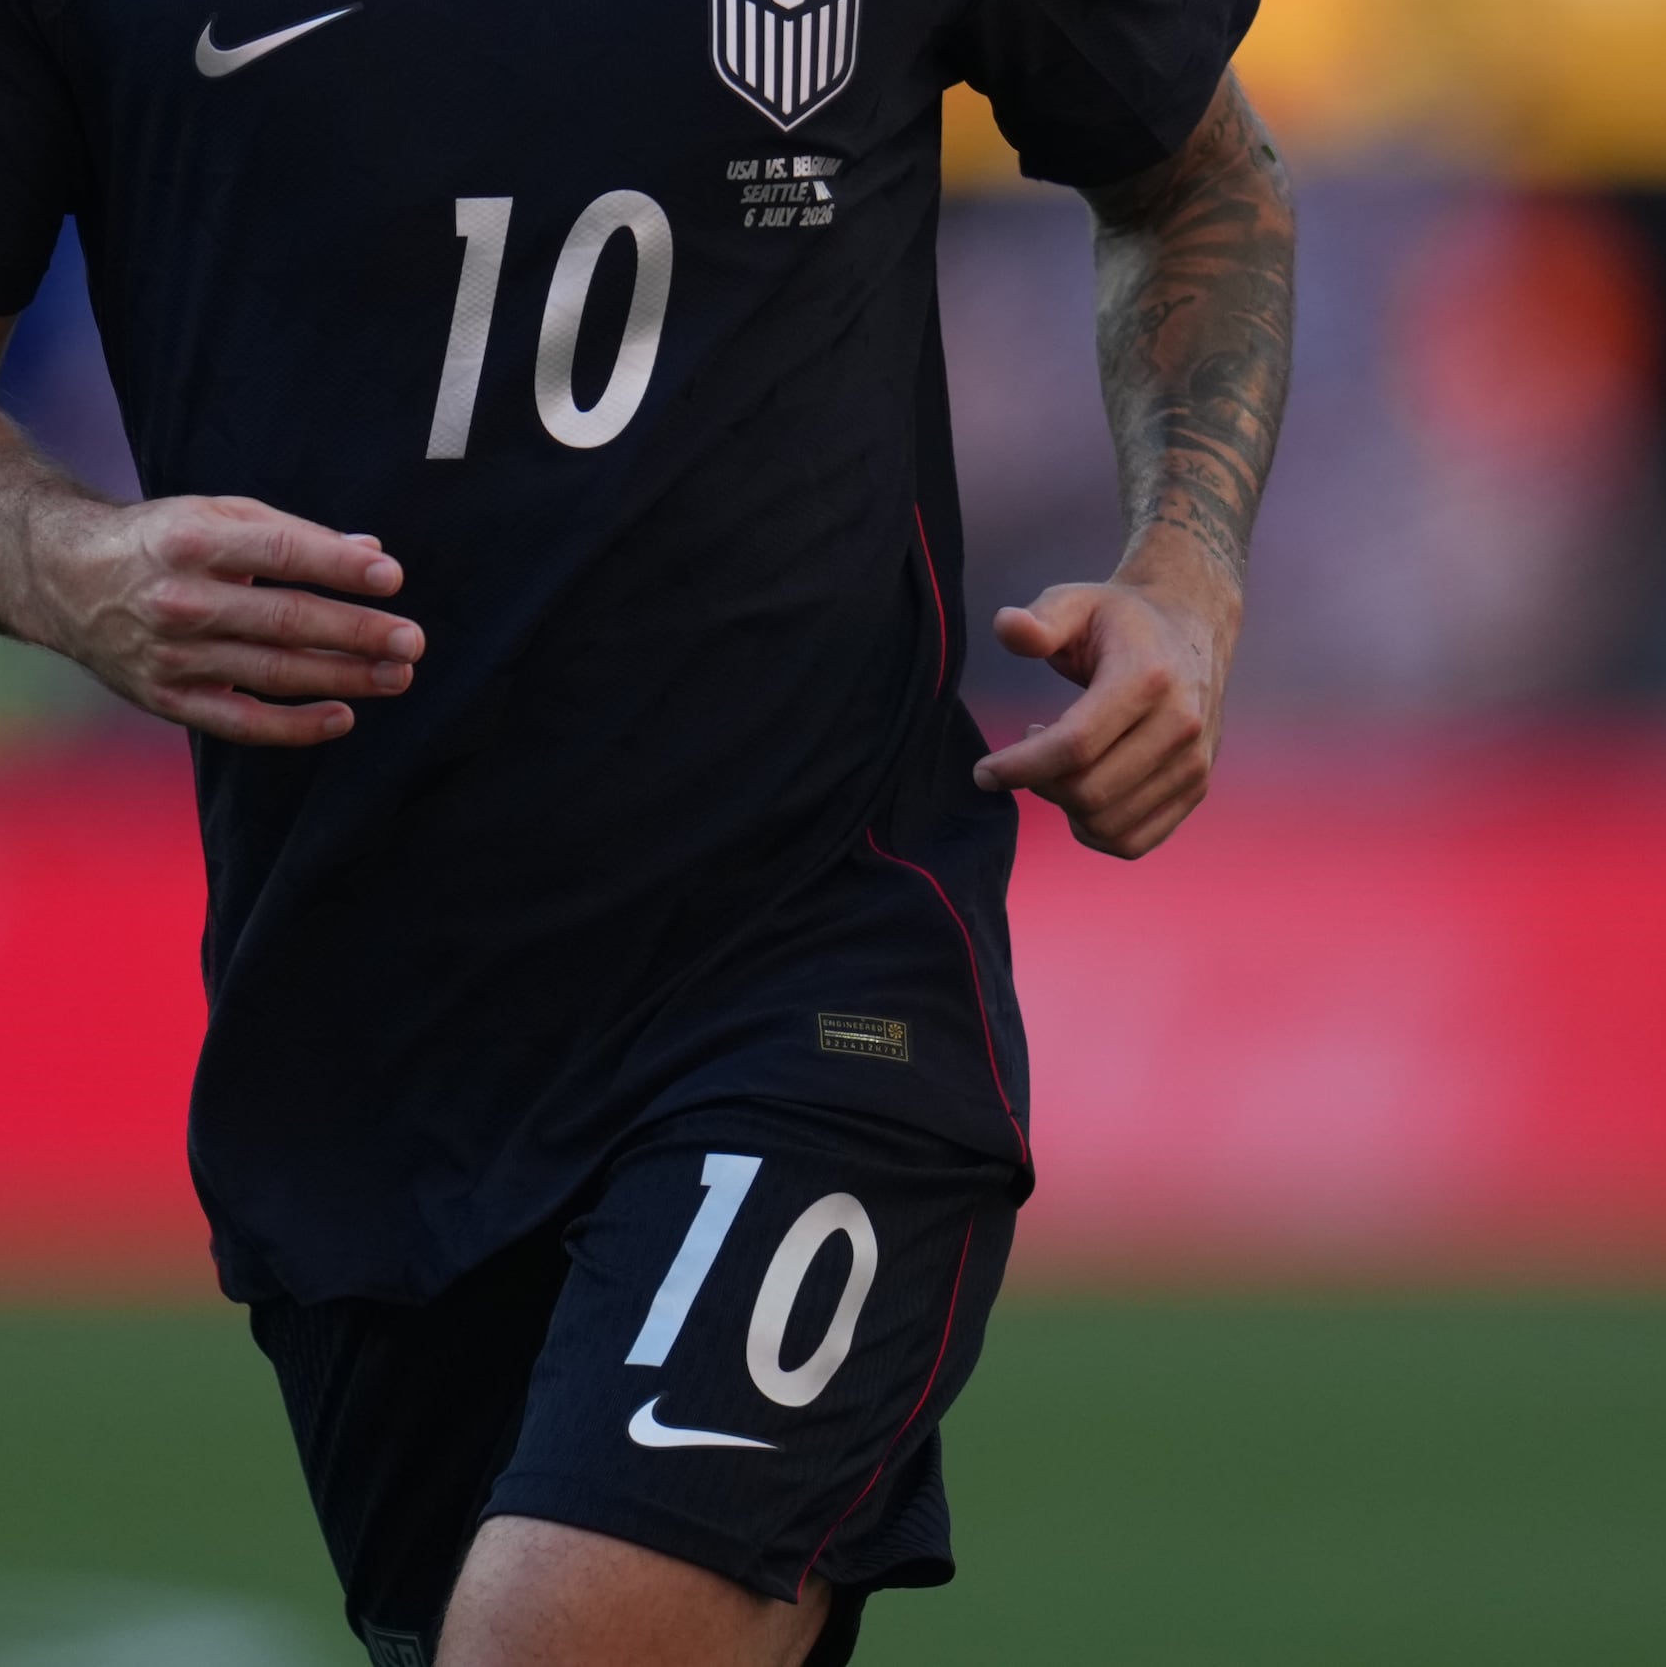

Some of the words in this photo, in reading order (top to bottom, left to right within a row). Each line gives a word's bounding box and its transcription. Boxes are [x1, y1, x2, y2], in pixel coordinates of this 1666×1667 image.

[725, 159, 759, 181] USA
[764, 157, 788, 180] VS.
[740, 181, 812, 206] SEATTLE,
[743, 207, 757, 229] 6
[758, 206, 798, 228] JULY
[799, 203, 836, 227] 2026
[425, 189, 674, 460] 10
[822, 1019, 883, 1031] ENGINEERED
[624, 1152, 879, 1407] 10
